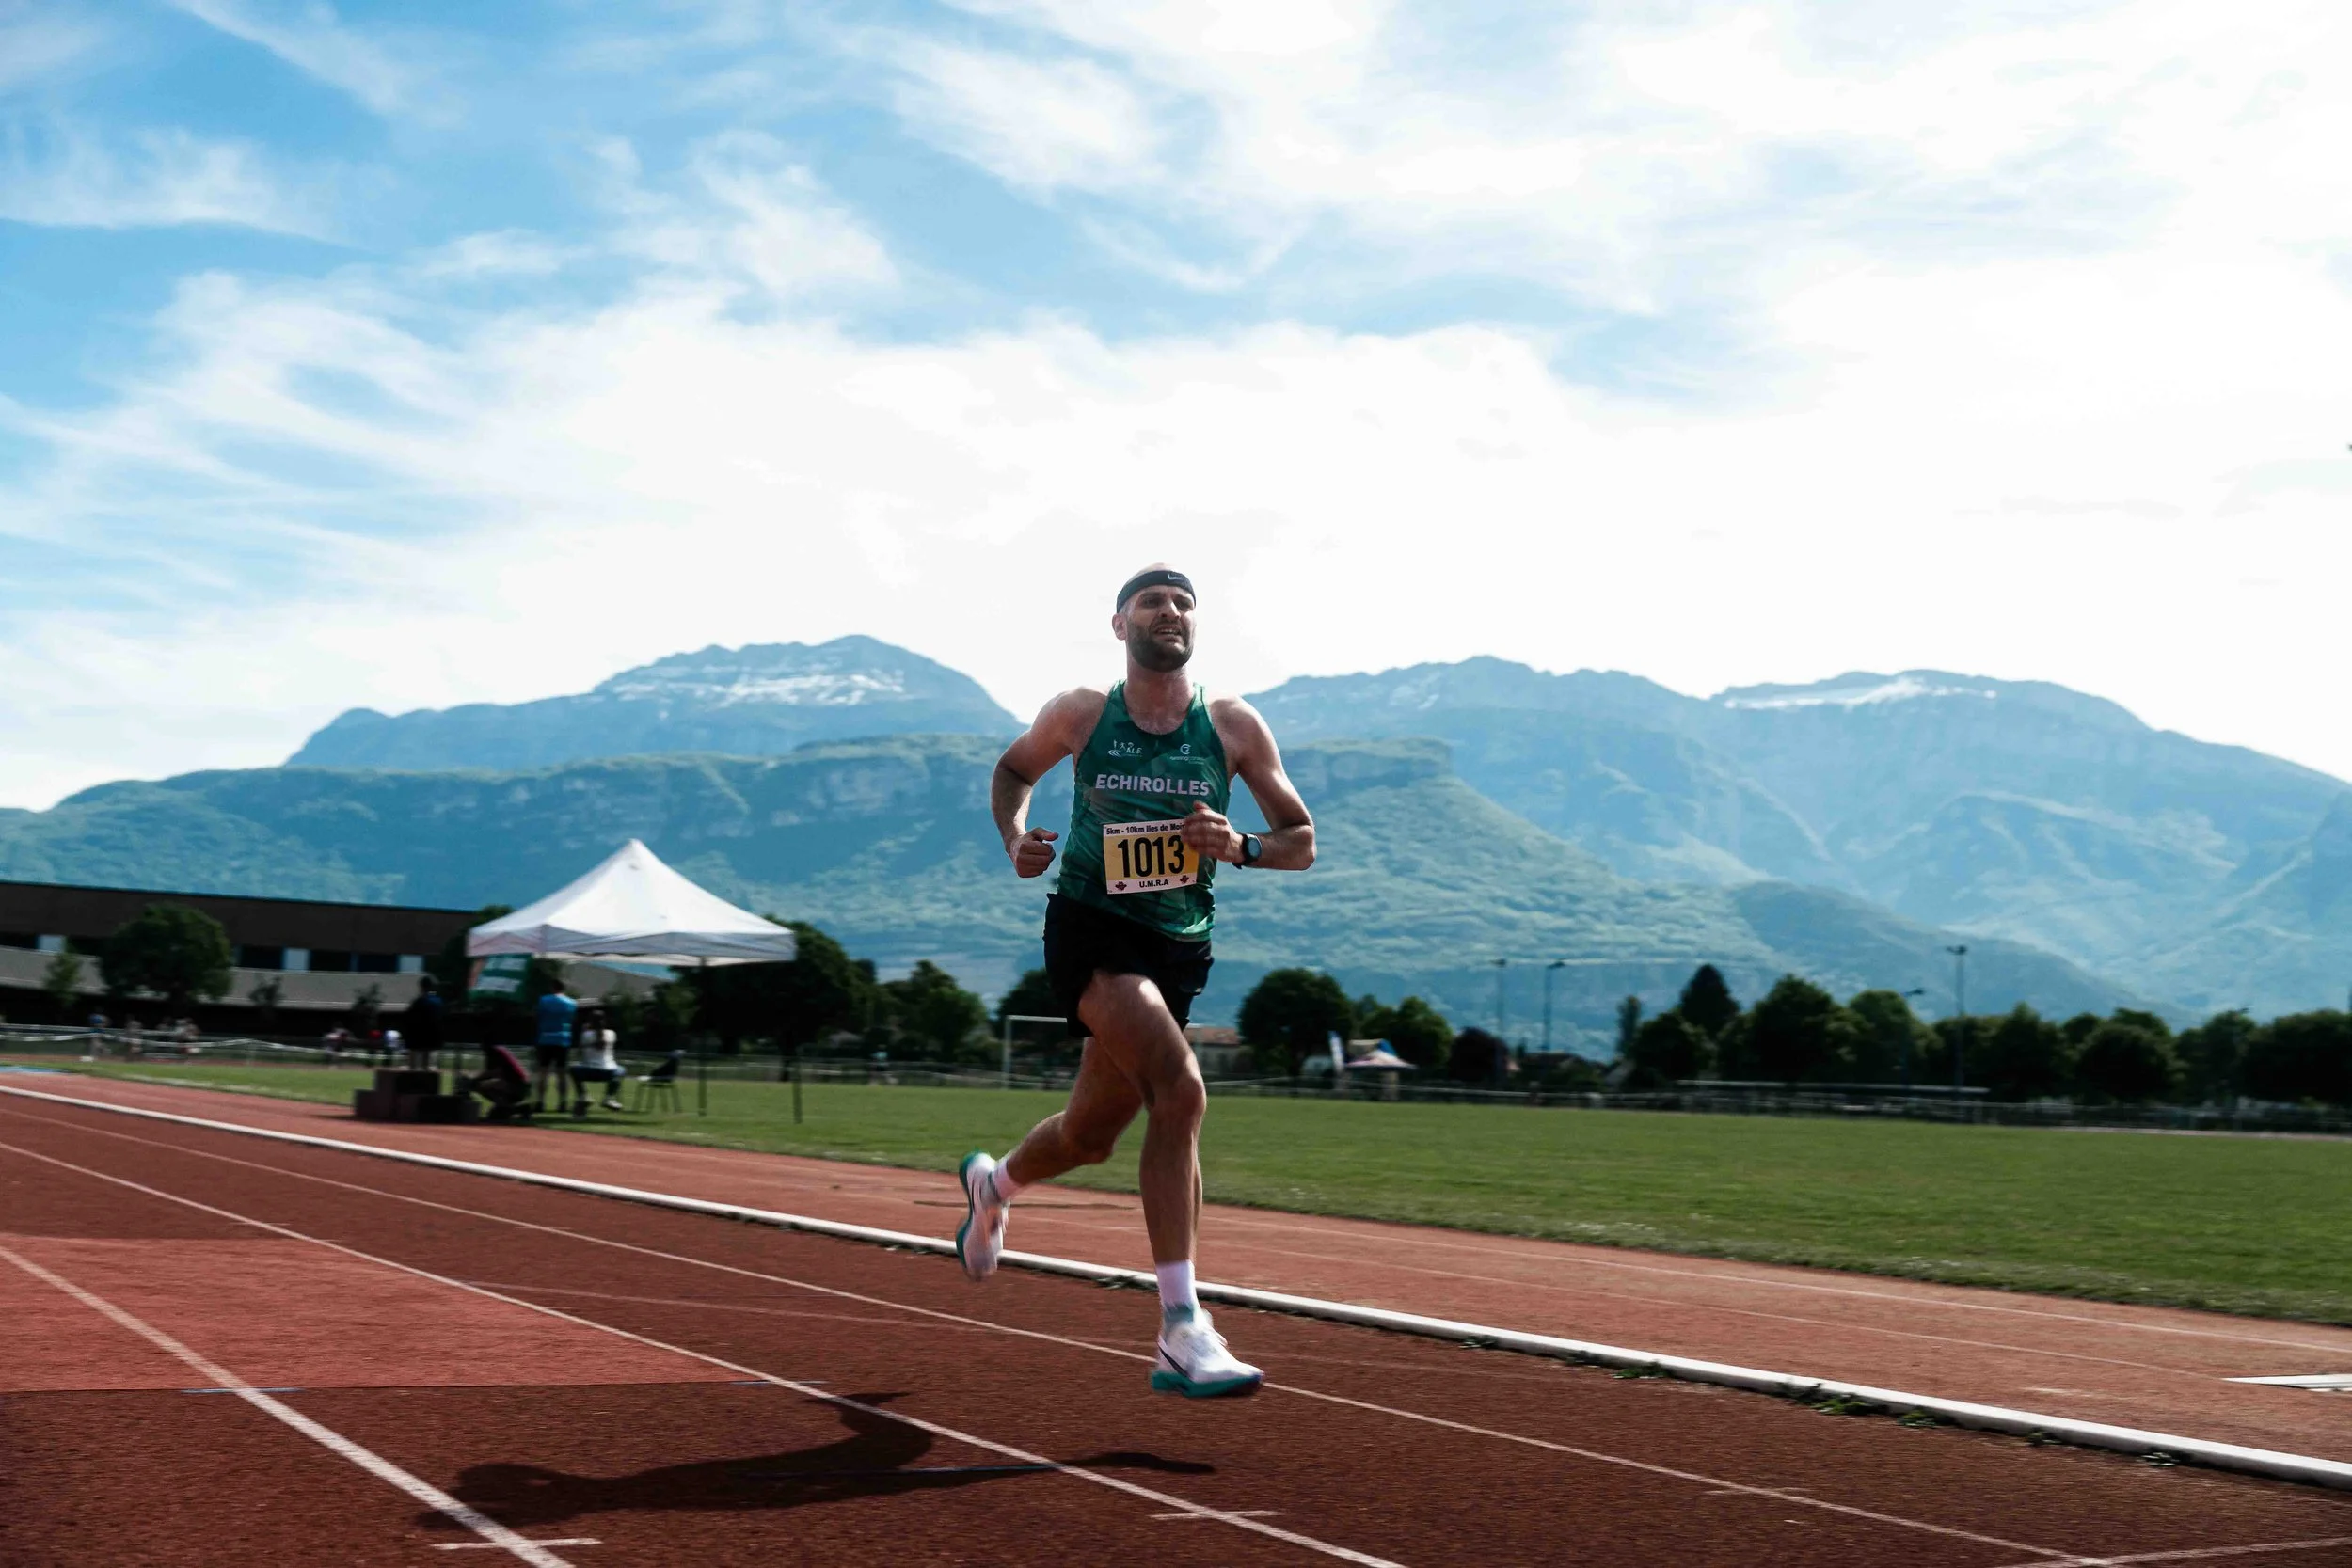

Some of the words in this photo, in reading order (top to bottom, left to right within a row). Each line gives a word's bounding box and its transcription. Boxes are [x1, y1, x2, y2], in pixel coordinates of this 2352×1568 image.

[1095, 774, 1210, 796] ECHIROLLES
[1118, 835, 1185, 878] 1013
[1139, 879, 1168, 888] U.M.R.A
